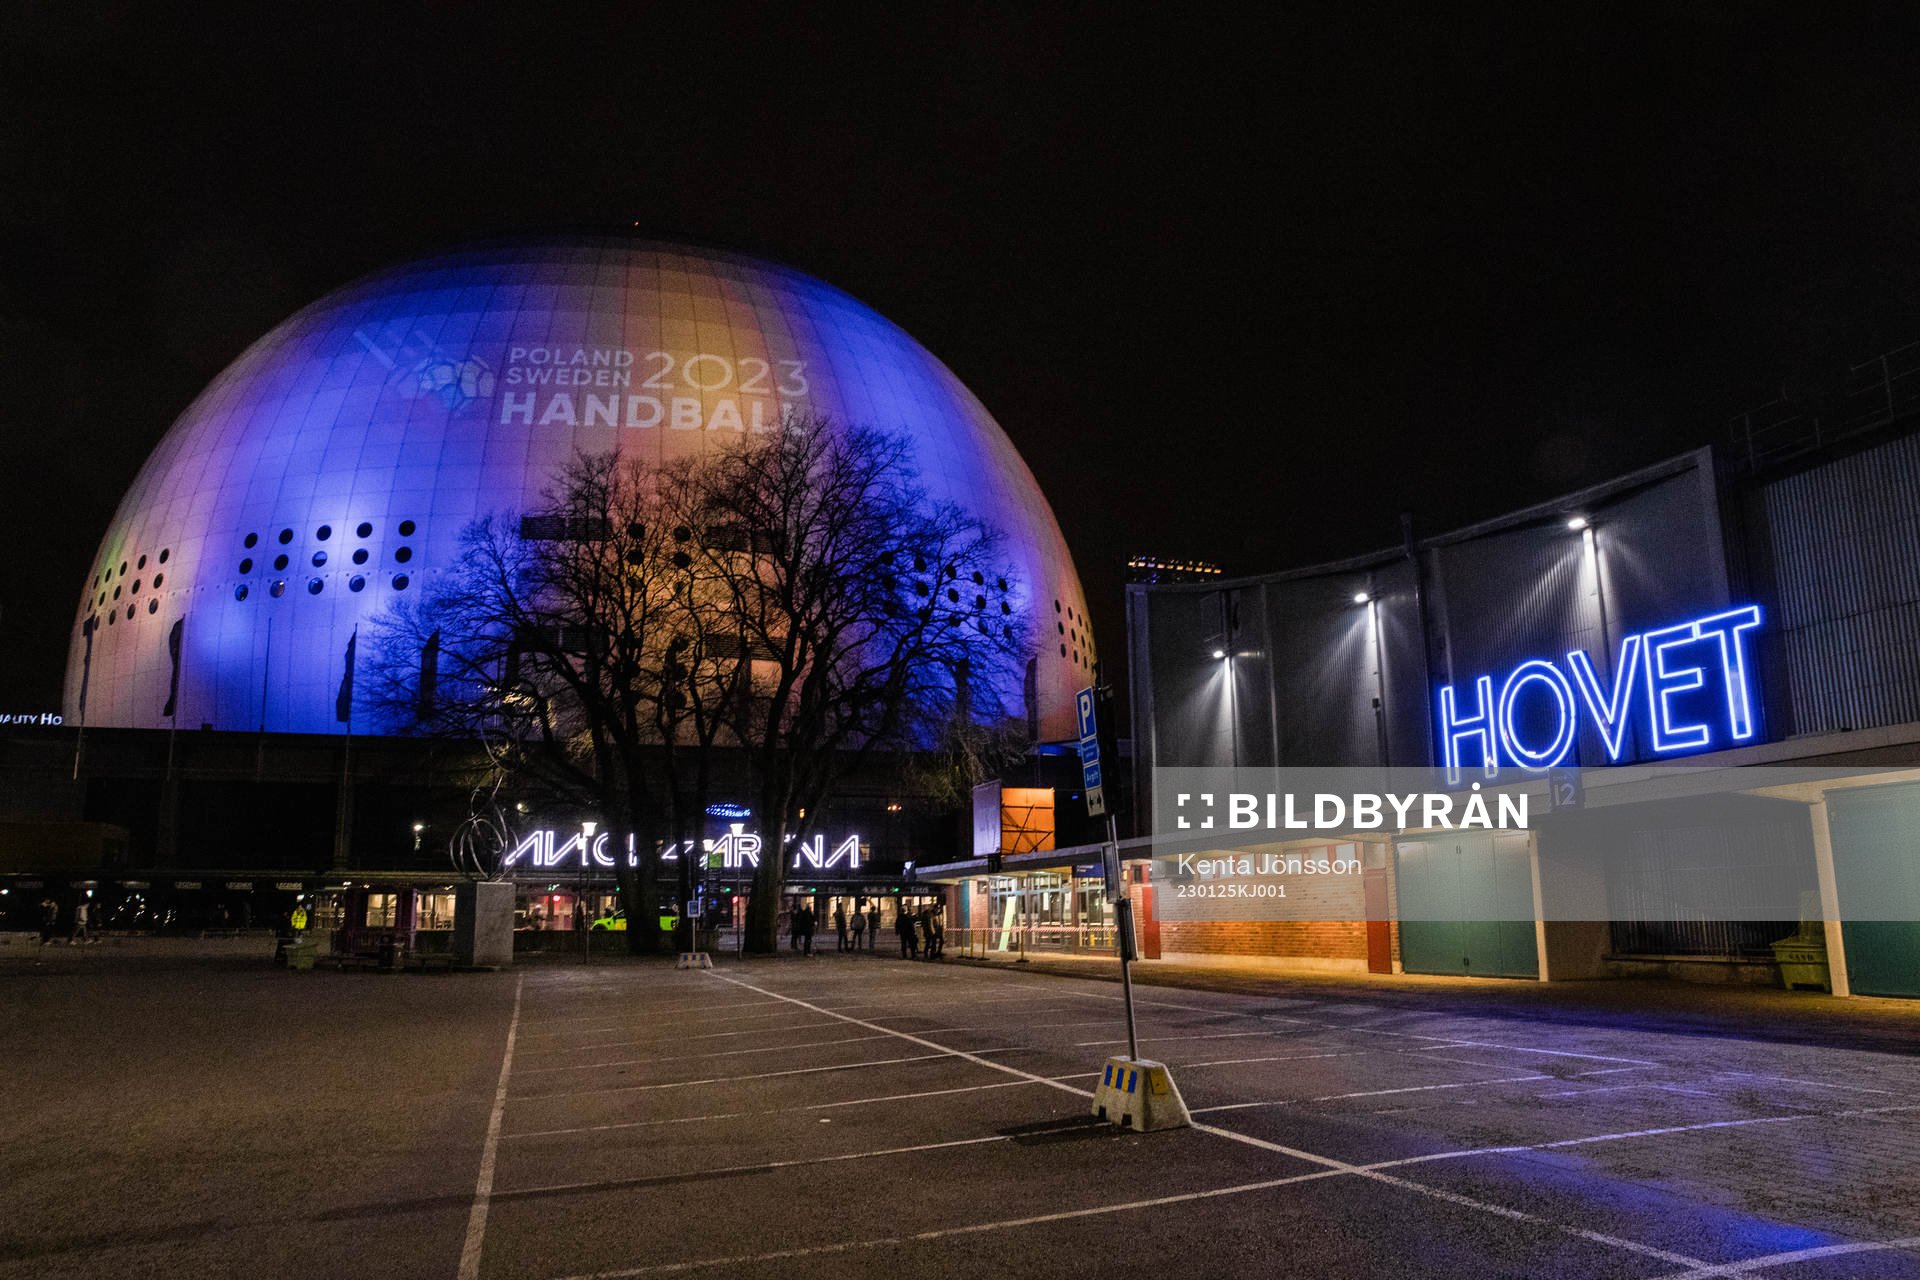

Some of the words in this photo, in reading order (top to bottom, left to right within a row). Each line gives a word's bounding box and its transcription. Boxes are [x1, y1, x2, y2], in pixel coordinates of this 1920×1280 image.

[509, 347, 634, 367] POLAND
[641, 351, 809, 396] 2023
[505, 367, 632, 387] SWEDEN
[1440, 604, 1761, 785] HOVET
[1080, 694, 1091, 734] P
[1553, 783, 1576, 806] 12
[504, 830, 640, 867] AVICI
[699, 833, 858, 868] ARNA
